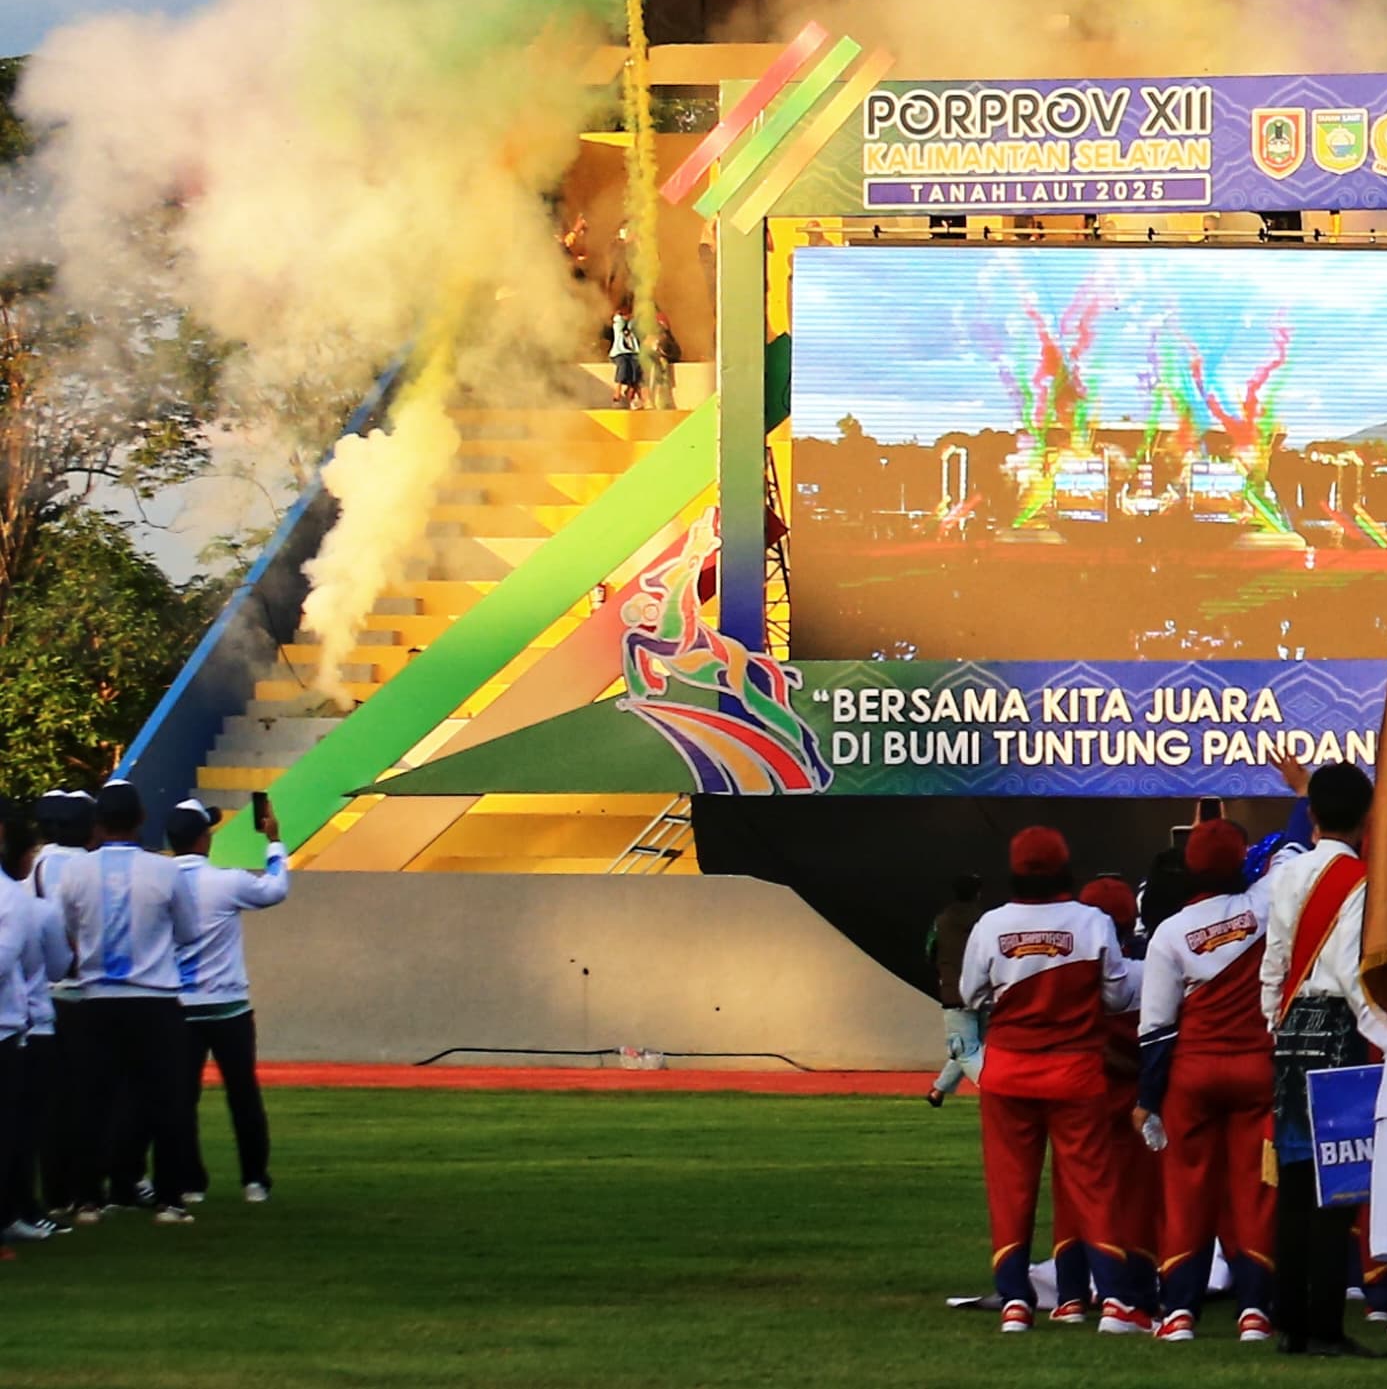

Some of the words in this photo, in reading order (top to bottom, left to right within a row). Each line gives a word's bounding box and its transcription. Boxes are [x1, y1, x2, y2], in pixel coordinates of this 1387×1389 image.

[866, 89, 1128, 138] PORPROV
[1142, 87, 1212, 135] XII
[865, 141, 1069, 172] KALIMANTAN
[1075, 139, 1211, 170] SELATAN
[911, 182, 1006, 202] TANAH
[1016, 182, 1086, 201] LAUT
[1096, 181, 1164, 200] 2025
[1043, 688, 1133, 723] KITA
[1145, 688, 1282, 723] JUARA
[832, 731, 871, 765] DI
[883, 731, 980, 765] BUMI
[993, 730, 1191, 765] TUNTUNG
[1203, 730, 1376, 765] PANDAN
[1320, 1138, 1373, 1166] BAN
